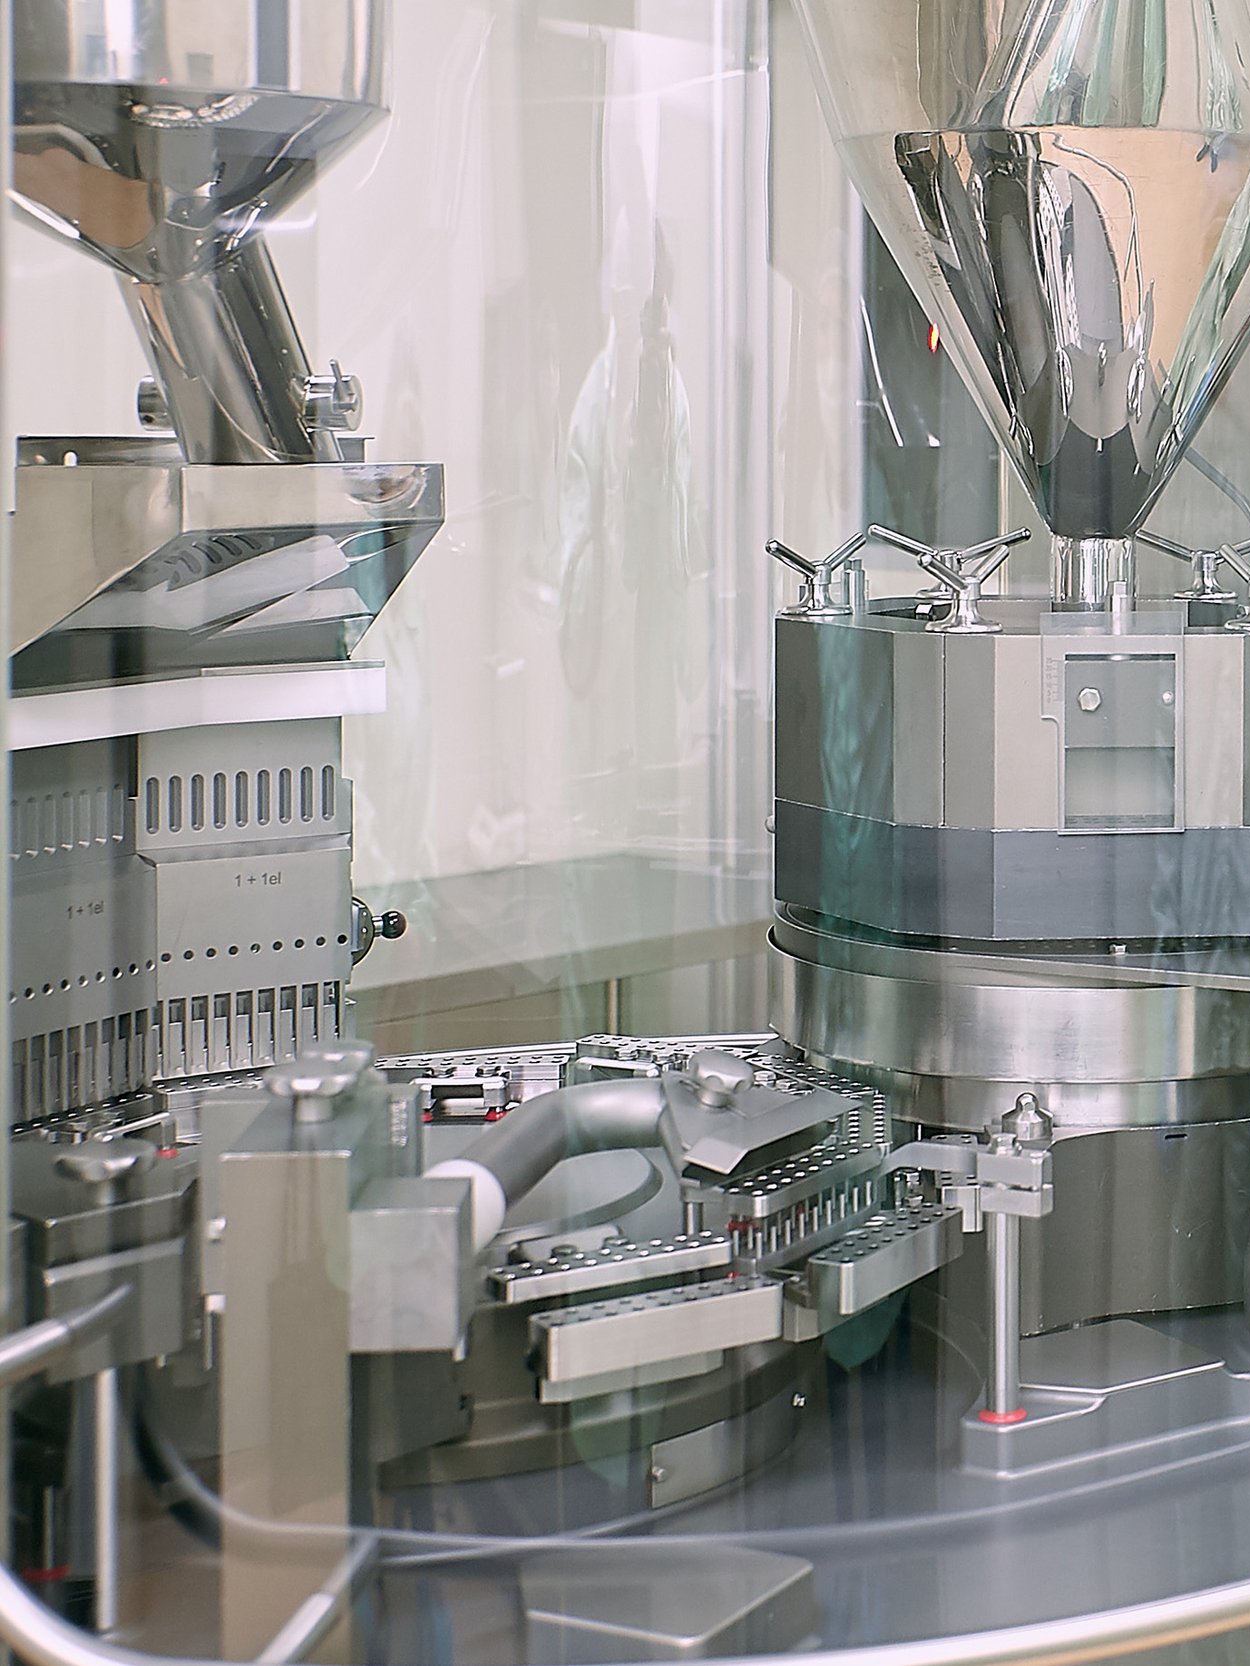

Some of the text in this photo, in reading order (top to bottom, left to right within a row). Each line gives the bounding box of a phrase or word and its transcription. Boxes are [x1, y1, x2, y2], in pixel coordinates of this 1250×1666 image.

[235, 874, 241, 887] 1
[247, 875, 256, 885] +
[67, 905, 73, 919] 1
